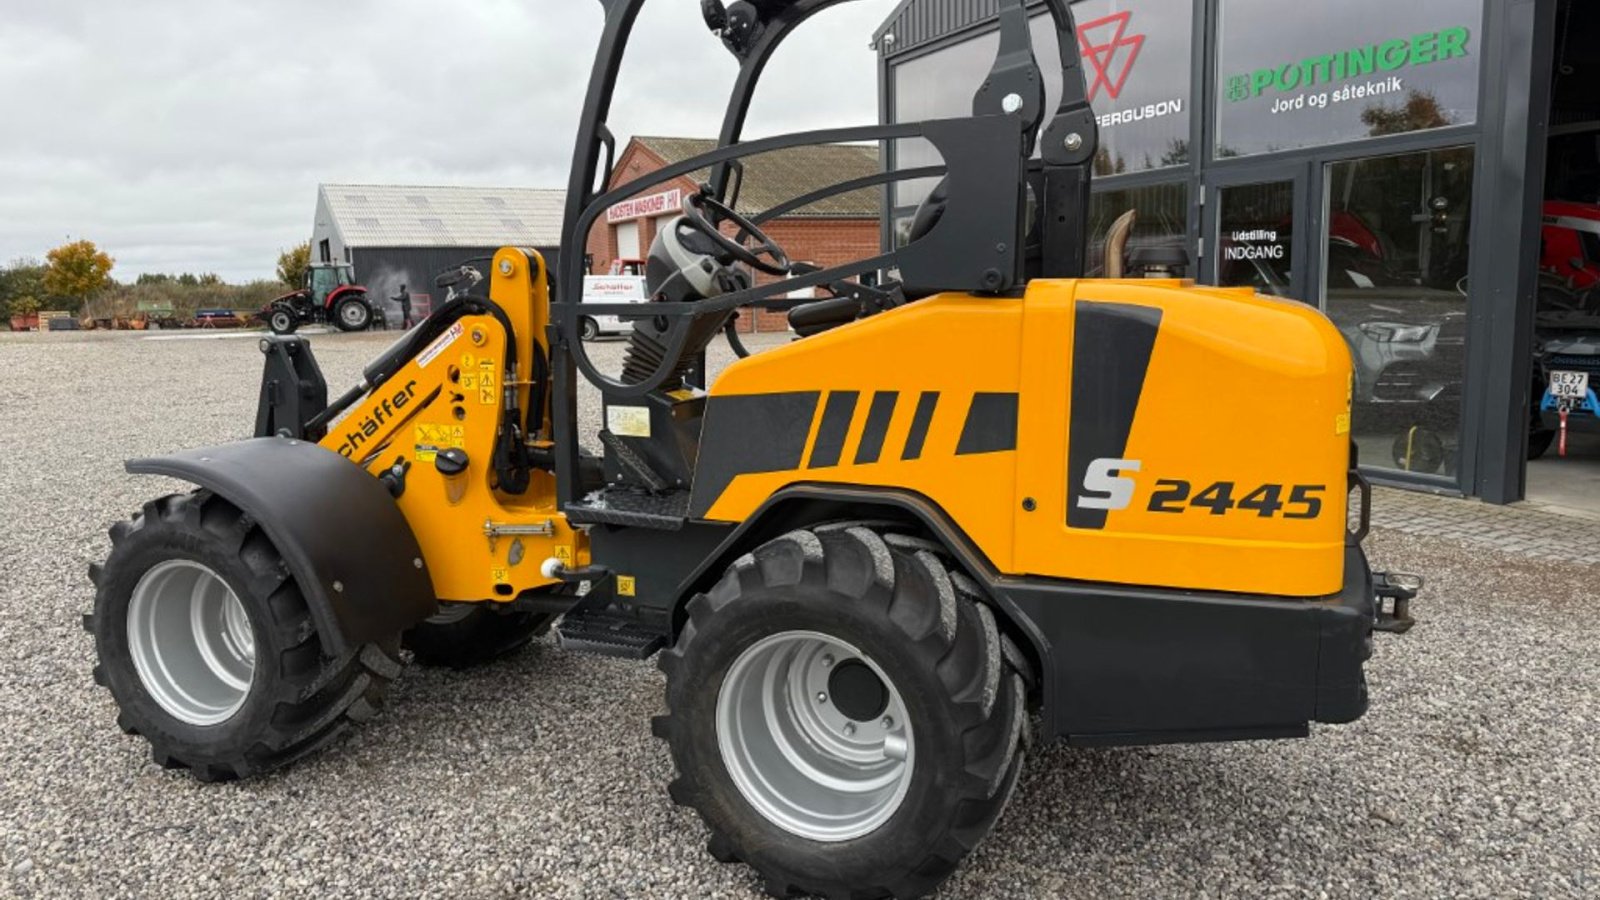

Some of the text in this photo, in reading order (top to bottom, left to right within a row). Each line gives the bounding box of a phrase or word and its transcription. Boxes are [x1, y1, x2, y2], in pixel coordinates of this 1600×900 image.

[1271, 76, 1402, 114] Jord og såteknik
[1095, 99, 1181, 127] FERGUSON
[1224, 244, 1284, 260] INDGANG
[1232, 230, 1277, 242] Udstilling
[338, 381, 417, 458] chäffer
[1076, 457, 1326, 520] S 2445
